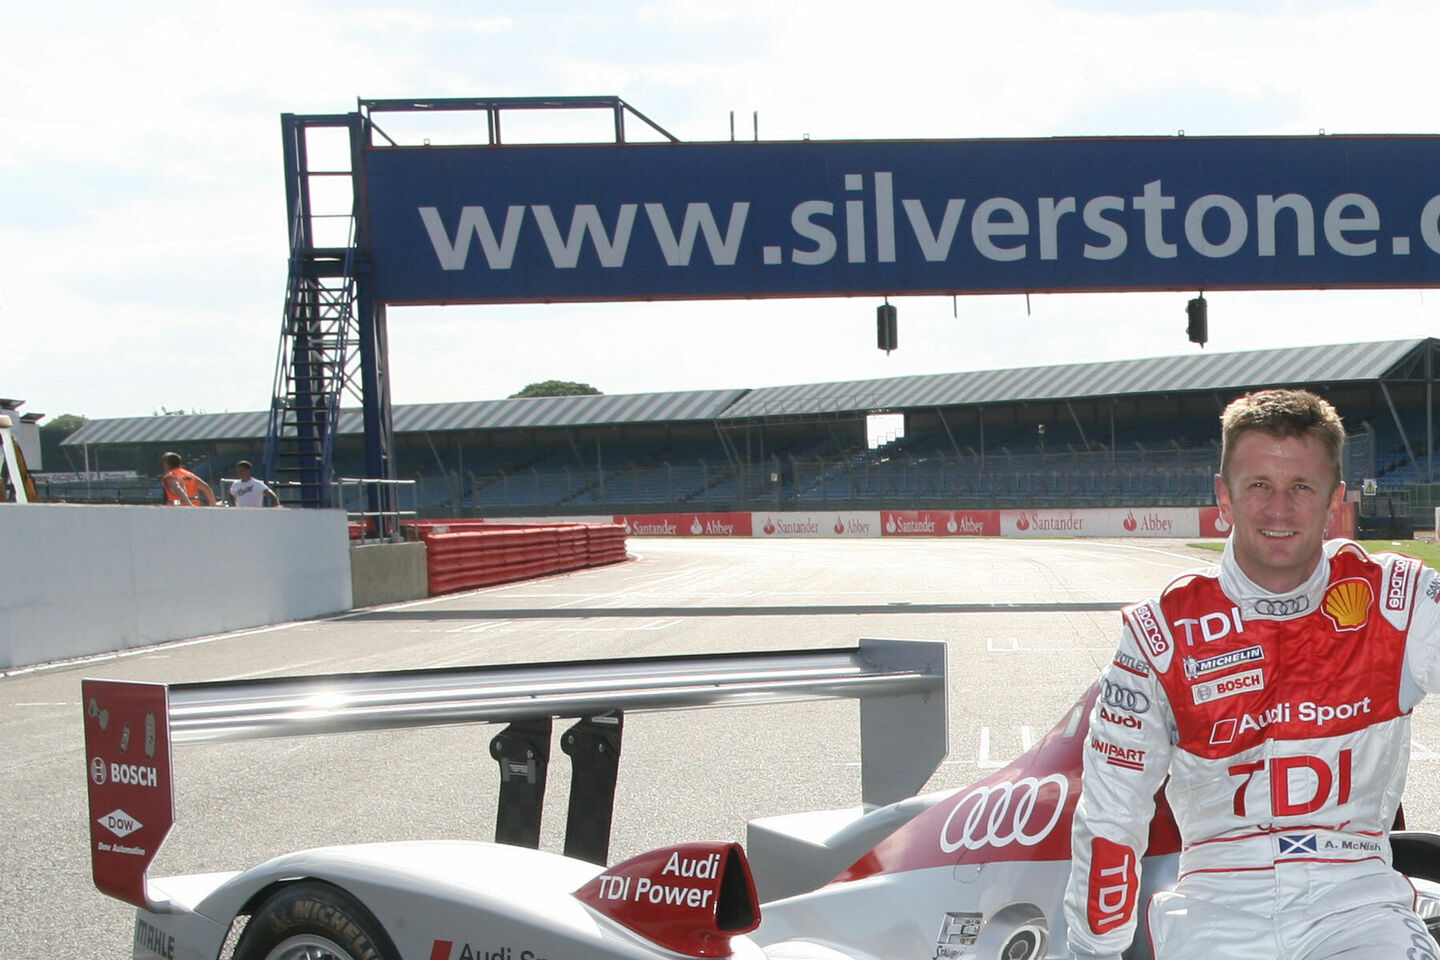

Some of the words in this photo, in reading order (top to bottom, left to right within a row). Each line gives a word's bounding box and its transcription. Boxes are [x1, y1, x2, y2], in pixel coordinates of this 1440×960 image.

[633, 520, 677, 536] Santander
[705, 519, 734, 536] Abbey
[777, 519, 819, 534] Santander
[847, 519, 869, 535] Abbey
[897, 517, 935, 533] Santander
[960, 517, 983, 535] Abbey
[1031, 512, 1083, 531] Santander
[1141, 513, 1173, 532] Abbey
[1387, 559, 1408, 610] sparco
[1136, 604, 1167, 653] sparco
[1174, 606, 1244, 647] TDI
[1200, 647, 1261, 671] MICHELIN
[1217, 674, 1260, 694] BOSCH
[1100, 707, 1142, 730] Audi
[1238, 703, 1291, 735] Audi
[1298, 696, 1371, 726] Sport
[1091, 735, 1146, 763] UNIPART
[110, 762, 158, 787] BOSCH
[1228, 749, 1353, 818] TDI
[1324, 840, 1339, 849] A.
[1341, 840, 1382, 852] McNish
[662, 851, 721, 880] Audi
[599, 875, 631, 901] TDI
[634, 877, 714, 908] Power
[1097, 853, 1130, 926] TDI
[137, 919, 176, 960] MAHLE
